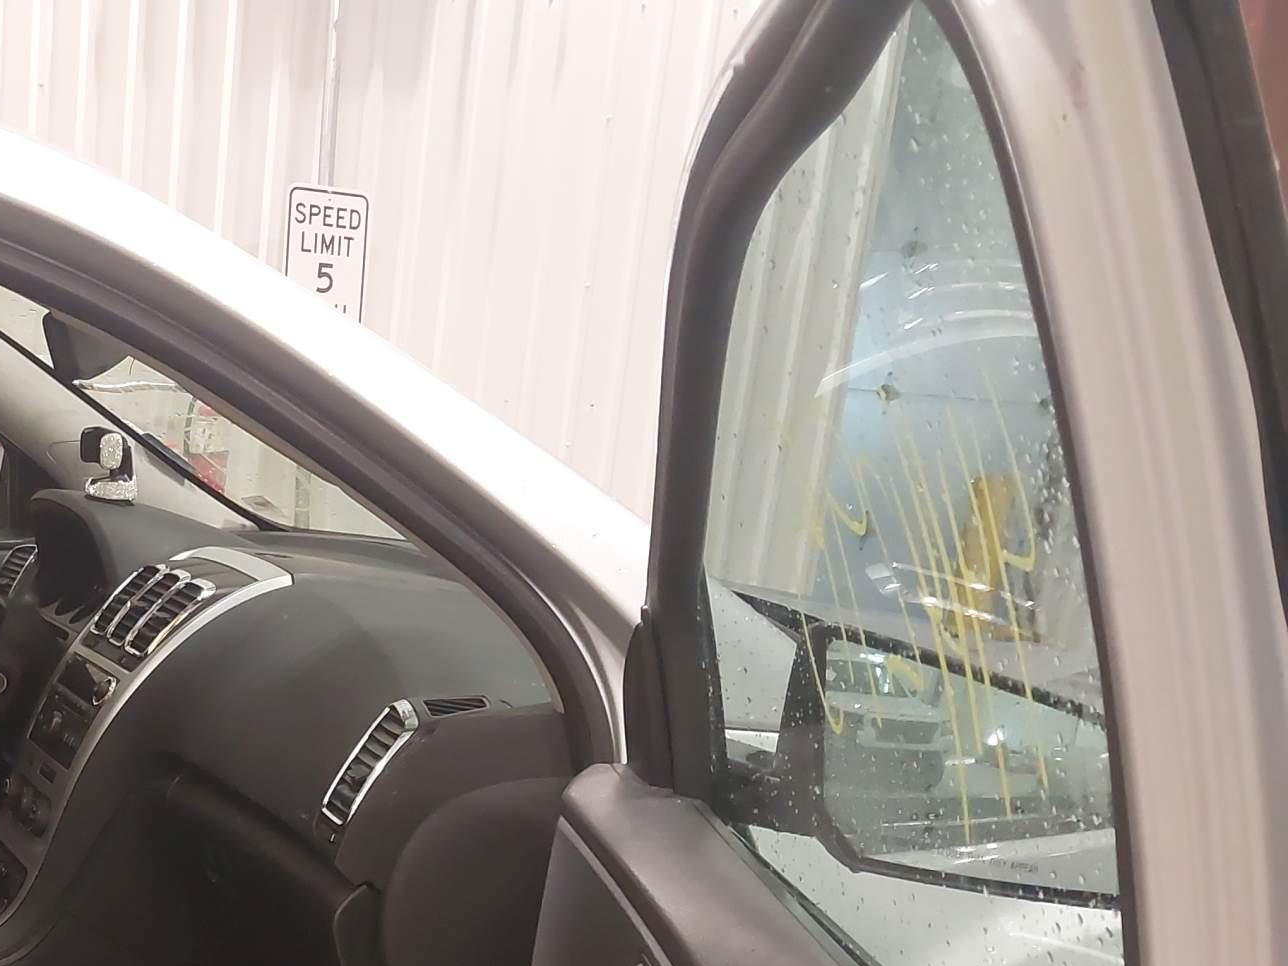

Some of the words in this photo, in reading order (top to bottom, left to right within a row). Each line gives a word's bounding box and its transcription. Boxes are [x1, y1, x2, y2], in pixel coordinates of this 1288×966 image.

[295, 202, 361, 230] SPEED
[300, 231, 354, 257] LIMIT
[316, 262, 334, 293] 5
